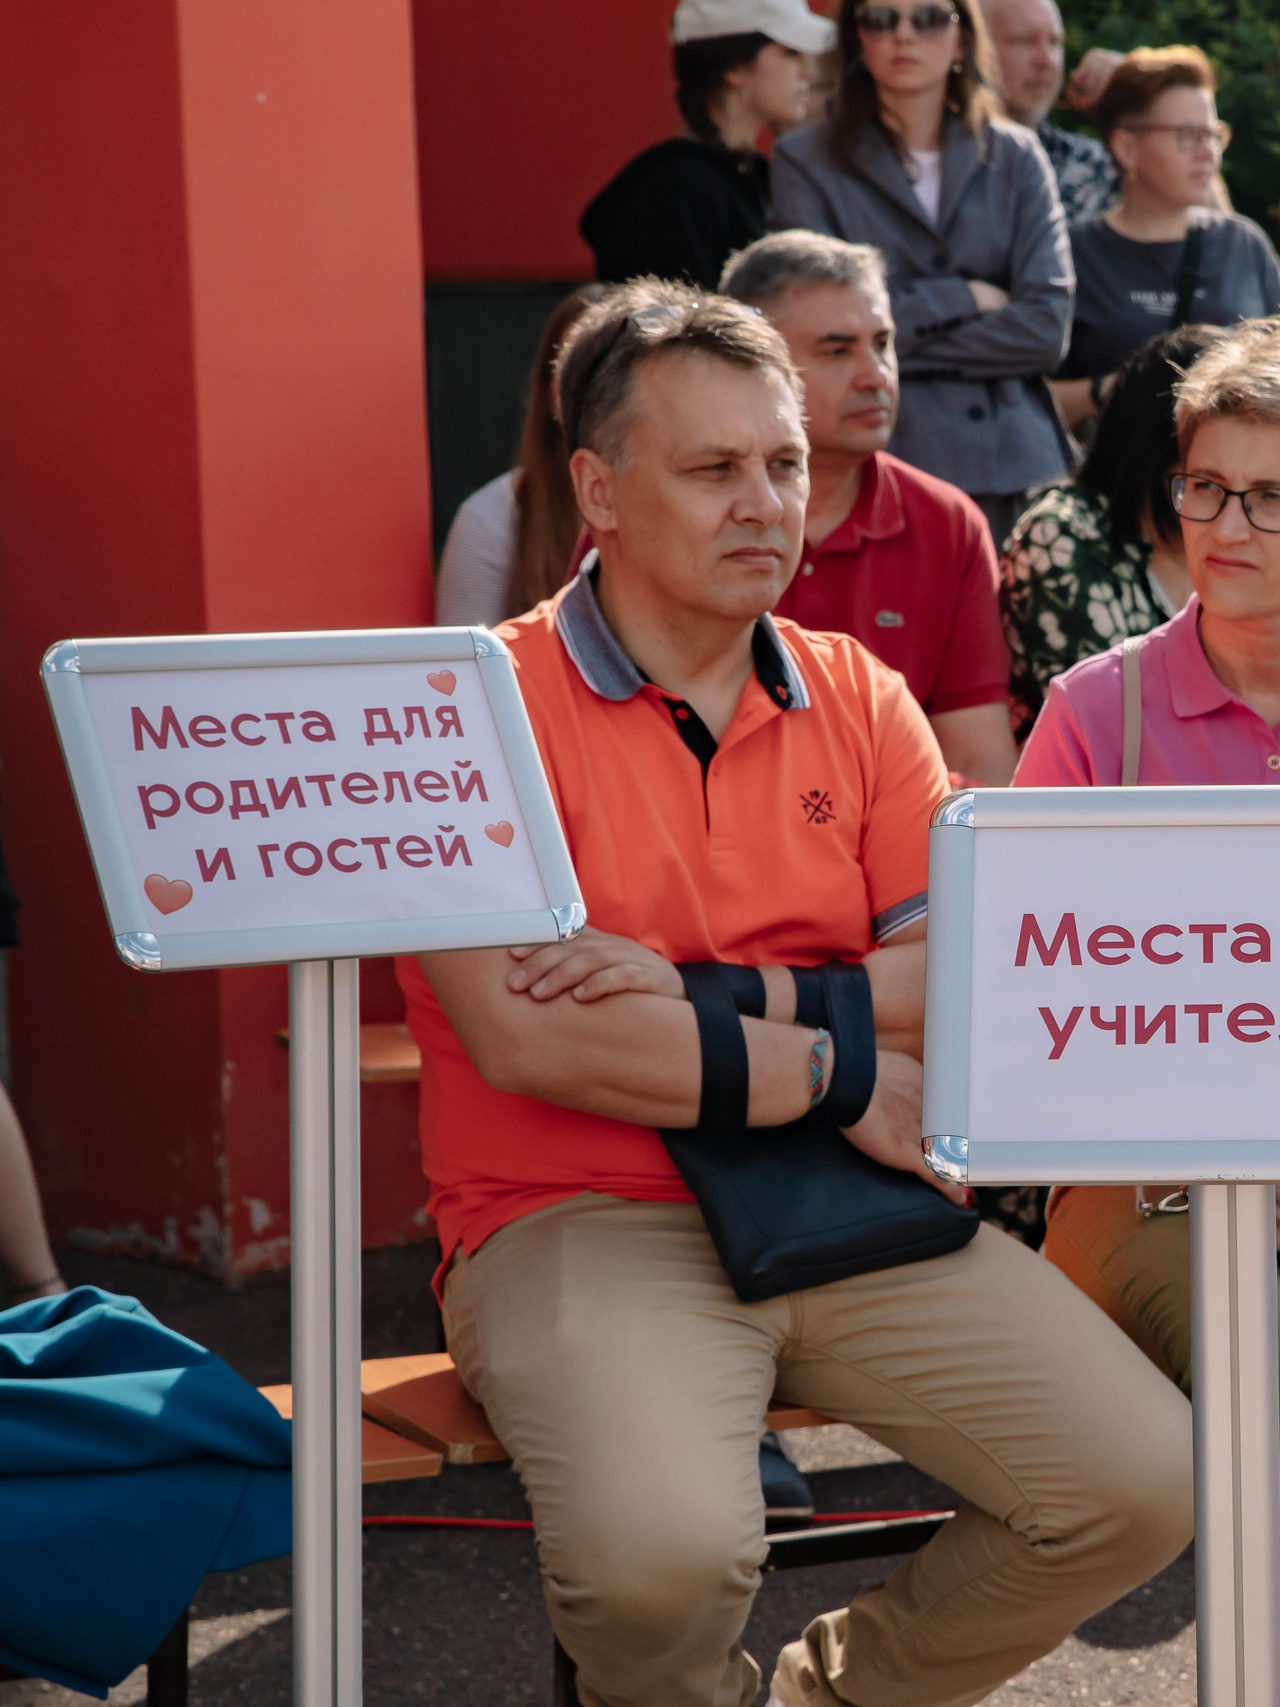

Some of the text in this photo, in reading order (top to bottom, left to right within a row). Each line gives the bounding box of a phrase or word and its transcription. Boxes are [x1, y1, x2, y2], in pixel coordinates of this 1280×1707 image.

[131, 705, 464, 751] Места для
[137, 760, 489, 830] родителей
[195, 825, 473, 882] и гостей
[1014, 913, 1271, 967] Места
